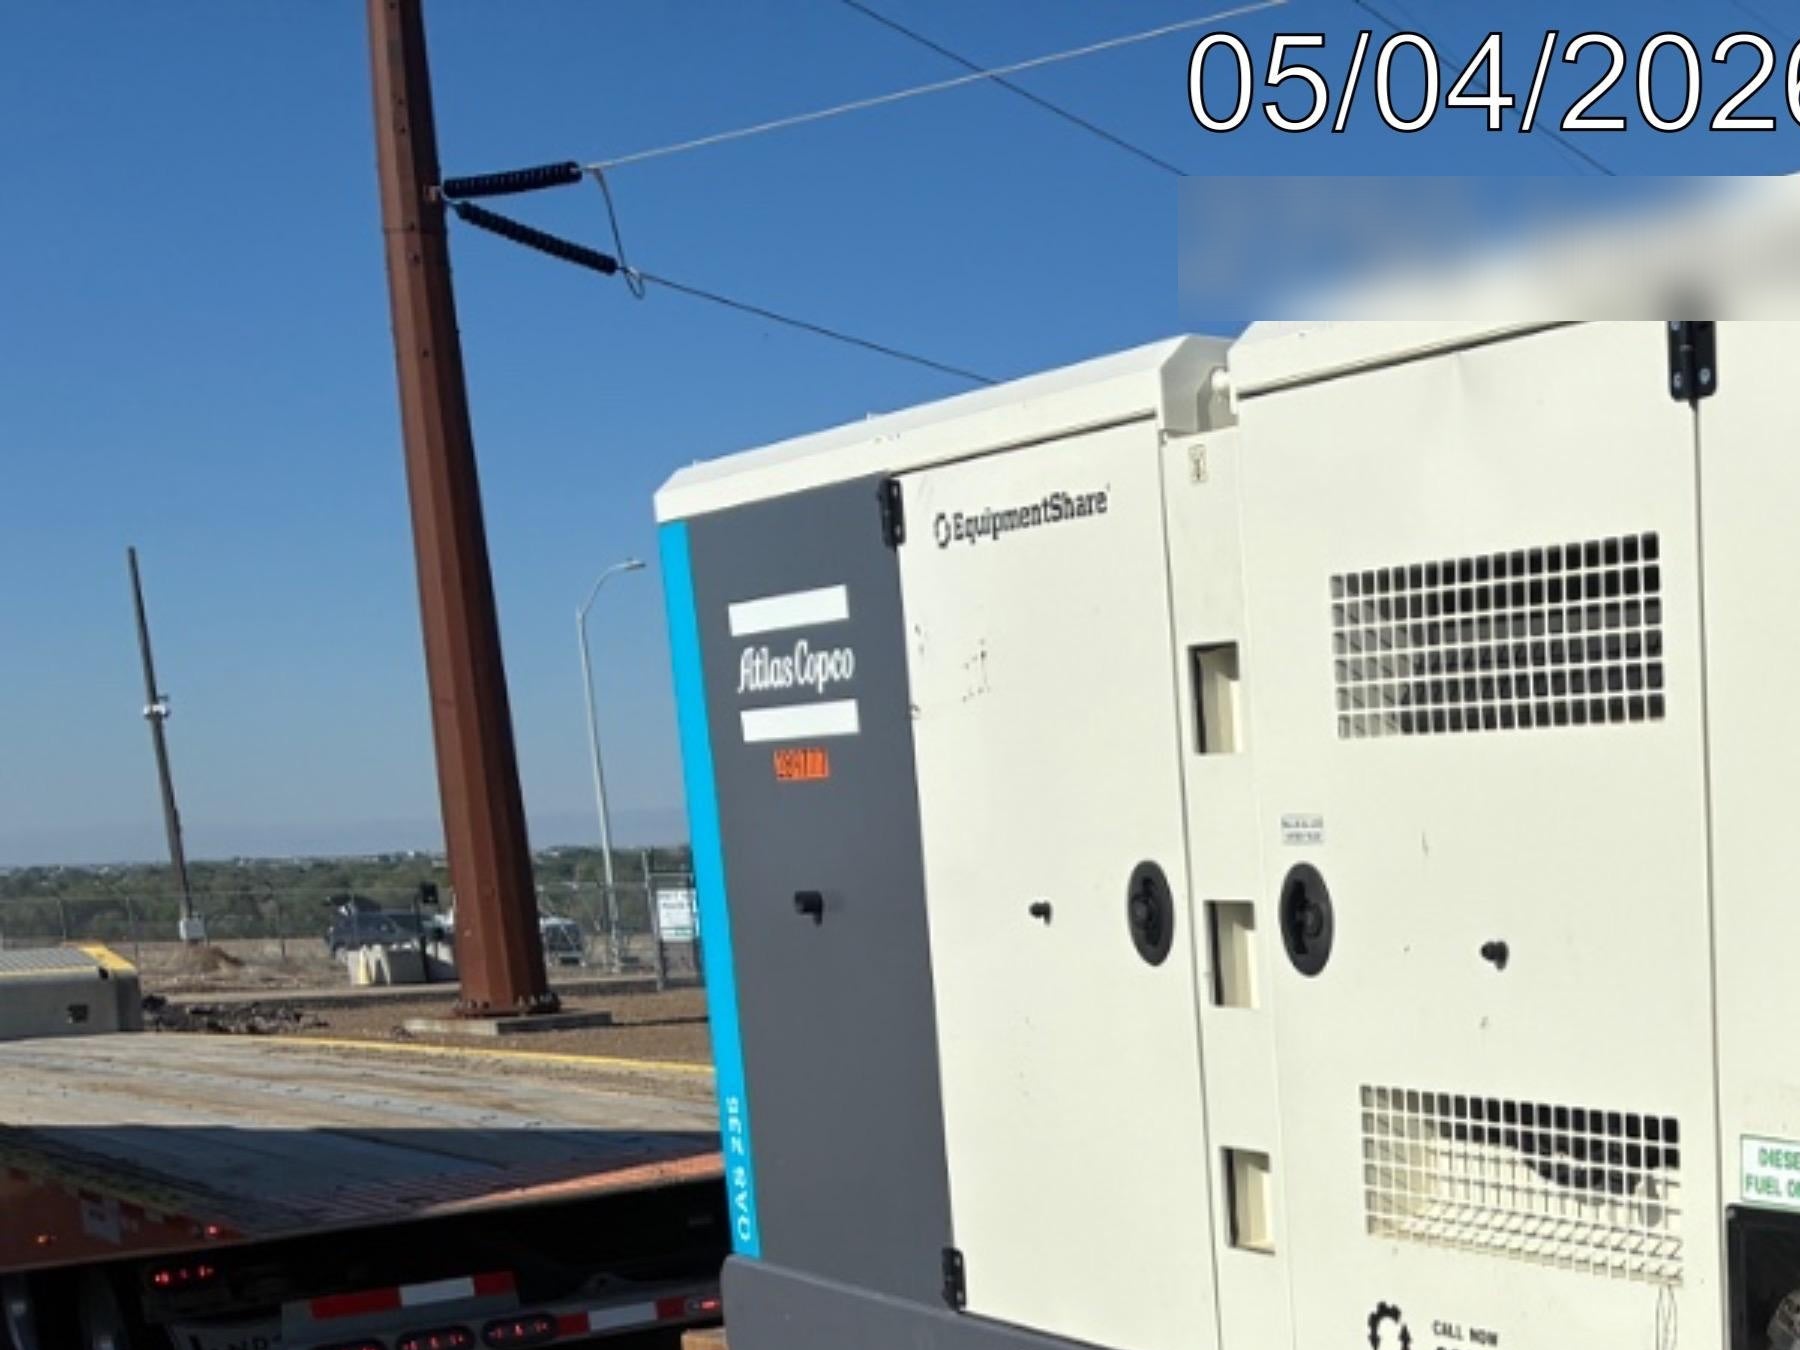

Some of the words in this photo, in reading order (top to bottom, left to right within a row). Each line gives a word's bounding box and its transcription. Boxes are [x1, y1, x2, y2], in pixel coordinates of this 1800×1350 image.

[952, 489, 1108, 545] EquipmentShare
[737, 646, 793, 694] Atlas
[794, 639, 856, 694] Copco
[1745, 1173, 1783, 1198] FUEL
[1432, 1318, 1464, 1342] CALL
[1468, 1326, 1499, 1348] NOW
